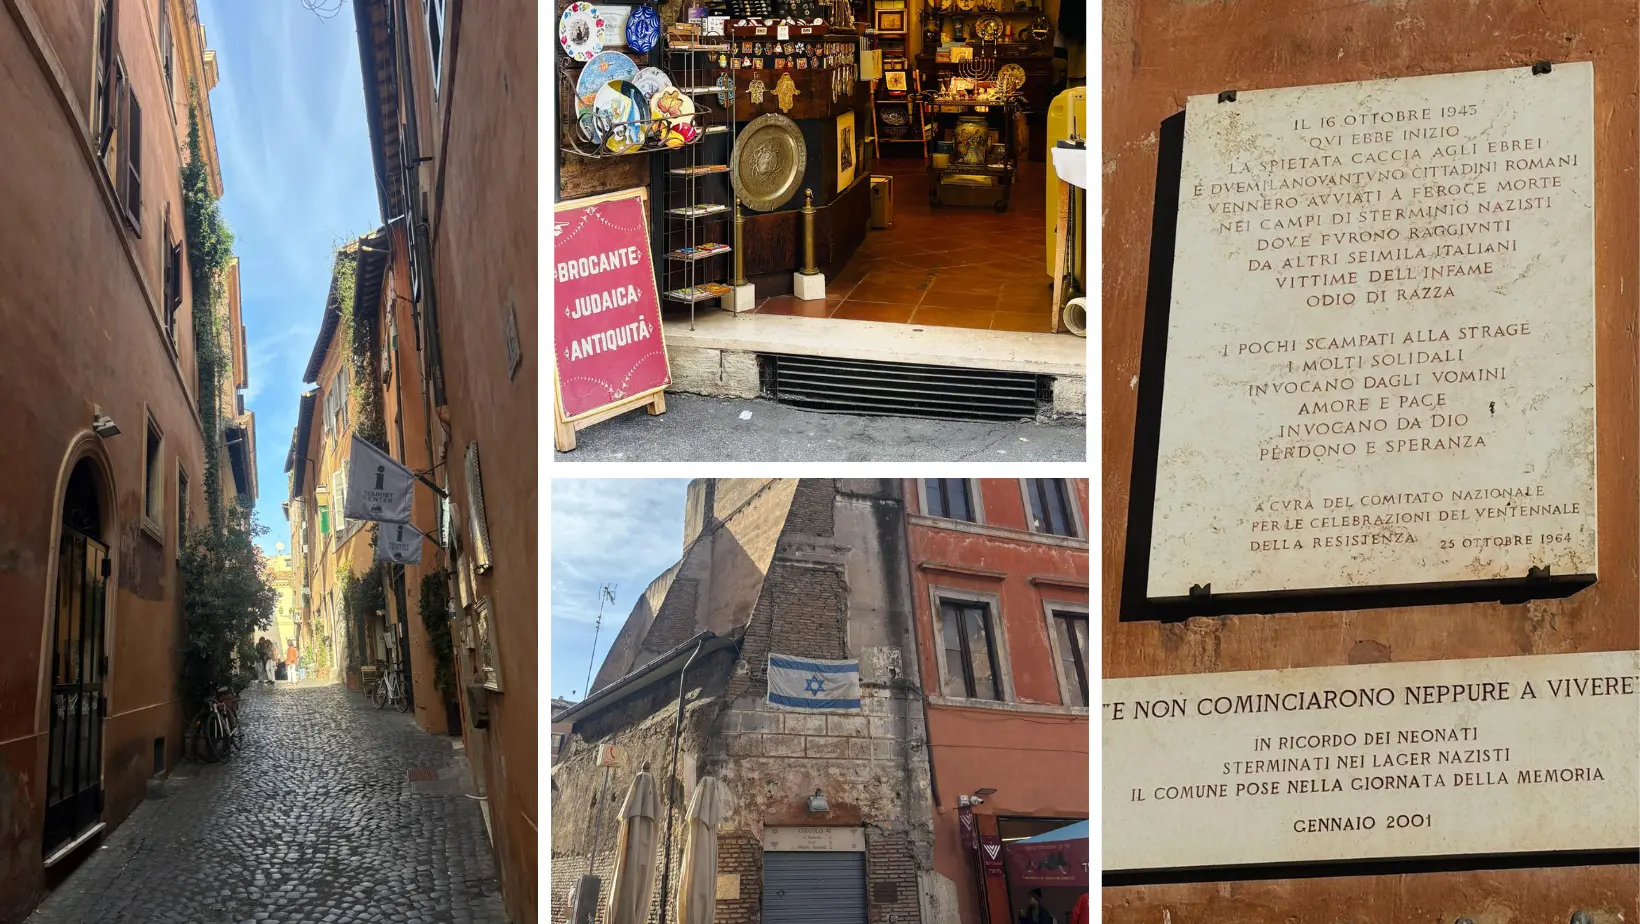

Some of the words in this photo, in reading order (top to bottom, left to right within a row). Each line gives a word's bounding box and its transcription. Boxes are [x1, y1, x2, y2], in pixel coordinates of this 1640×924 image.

[1294, 119, 1310, 131] IL
[1320, 116, 1335, 128] 16
[1345, 108, 1431, 126] OTTOBRE
[1310, 135, 1342, 150] QVI
[1352, 130, 1392, 145] EBBE
[1404, 125, 1459, 140] INIZIO
[1228, 161, 1249, 175] LA
[1259, 156, 1343, 172] SPIETATA
[1352, 149, 1423, 164] CACCIA
[1432, 144, 1477, 158] AGLI
[1488, 138, 1542, 153] EBREI
[1194, 184, 1202, 196] E
[1411, 162, 1497, 178] CITTADINI
[1506, 154, 1578, 172] ROMANI
[1208, 197, 1298, 214] VENNERO
[1307, 190, 1382, 206] AVVIATI
[1392, 188, 1402, 201] A
[1412, 182, 1487, 198] FEROCE
[1497, 176, 1562, 191] MORTE
[1220, 219, 1251, 233] NEI
[1260, 215, 1322, 230] CAMPI
[1332, 211, 1351, 224] DI
[1358, 203, 1469, 223] STERMINIO
[1479, 197, 1552, 213] NAZISTI
[1257, 236, 1311, 251] DOVE
[1321, 228, 1400, 246] FVRONO
[1410, 219, 1511, 239] RAGGIVNTI
[557, 246, 638, 283] BROCANTE
[1249, 257, 1273, 271] DA
[1282, 253, 1338, 268] ALTRI
[1348, 248, 1426, 263] SEIMILA
[1436, 239, 1518, 257] ITALIANI
[1275, 272, 1357, 289] VITTIME
[571, 284, 638, 319] JUDAICA
[1307, 292, 1356, 308] ODIO
[1367, 290, 1386, 303] DI
[1397, 286, 1455, 300] RAZZA
[1222, 344, 1228, 357] I
[1238, 340, 1297, 355] POCHI
[1306, 333, 1394, 350] SCAMPATI
[1402, 329, 1450, 344] ALLA
[1459, 323, 1531, 340] STRAGE
[1288, 360, 1293, 372] I
[1303, 356, 1364, 372] MOLTI
[1372, 349, 1464, 367] SOLIDALI
[1249, 378, 1355, 397] INVOCANO
[1364, 374, 1421, 388] DAGLI
[1432, 367, 1506, 383] VOMINI
[1298, 399, 1368, 415] AMORE
[1380, 397, 1389, 410] E
[1399, 393, 1447, 409] PACE
[1280, 419, 1388, 437] INVOCANO
[1397, 416, 1421, 430] DA
[1431, 413, 1469, 428] DIO
[1259, 443, 1356, 461] PERDONO
[1367, 441, 1376, 454] E
[1386, 435, 1486, 453] SPERANZA
[364, 490, 394, 498] TOURIST
[1255, 501, 1265, 512] A
[1270, 499, 1313, 511] CVRA
[1324, 495, 1352, 509] DEL
[1360, 491, 1444, 506] COMITATO
[1452, 485, 1545, 501] NAZIONALE
[1251, 520, 1281, 533] PER
[1286, 519, 1303, 530] LE
[1310, 511, 1431, 528] CELEBRAZIONI
[1439, 508, 1470, 522] DEL
[1475, 503, 1580, 518] VENTENNALE
[1250, 537, 1303, 551] DELLA
[1313, 532, 1415, 548] RESISTENZA
[1440, 539, 1456, 550] 25
[1462, 534, 1532, 548] OTTOBRE
[1541, 532, 1571, 545] 1964
[1134, 700, 1187, 720] NON
[1197, 687, 1395, 716] COMINCIARONO
[1405, 681, 1510, 705] NEPPURE
[1520, 681, 1537, 700] A
[1254, 735, 1271, 751] IN
[1279, 734, 1357, 750] RICORDO
[1365, 731, 1391, 745] DEI
[1398, 727, 1478, 744] NEONATI
[1223, 756, 1330, 775] STERMINATI
[1337, 754, 1365, 768] NEI
[1373, 751, 1431, 767] LAGER
[1438, 748, 1510, 764] NAZISTI
[1131, 787, 1145, 803] IL
[1154, 785, 1227, 800] COMUNE
[1236, 780, 1280, 797] POSE
[1287, 779, 1343, 793] NELLA
[1351, 775, 1446, 791] GIORNATA
[1454, 770, 1509, 787] DELLA
[1517, 767, 1605, 783] MEMORIA
[1293, 816, 1375, 833] GENNAIO
[1387, 813, 1432, 829] 2001
